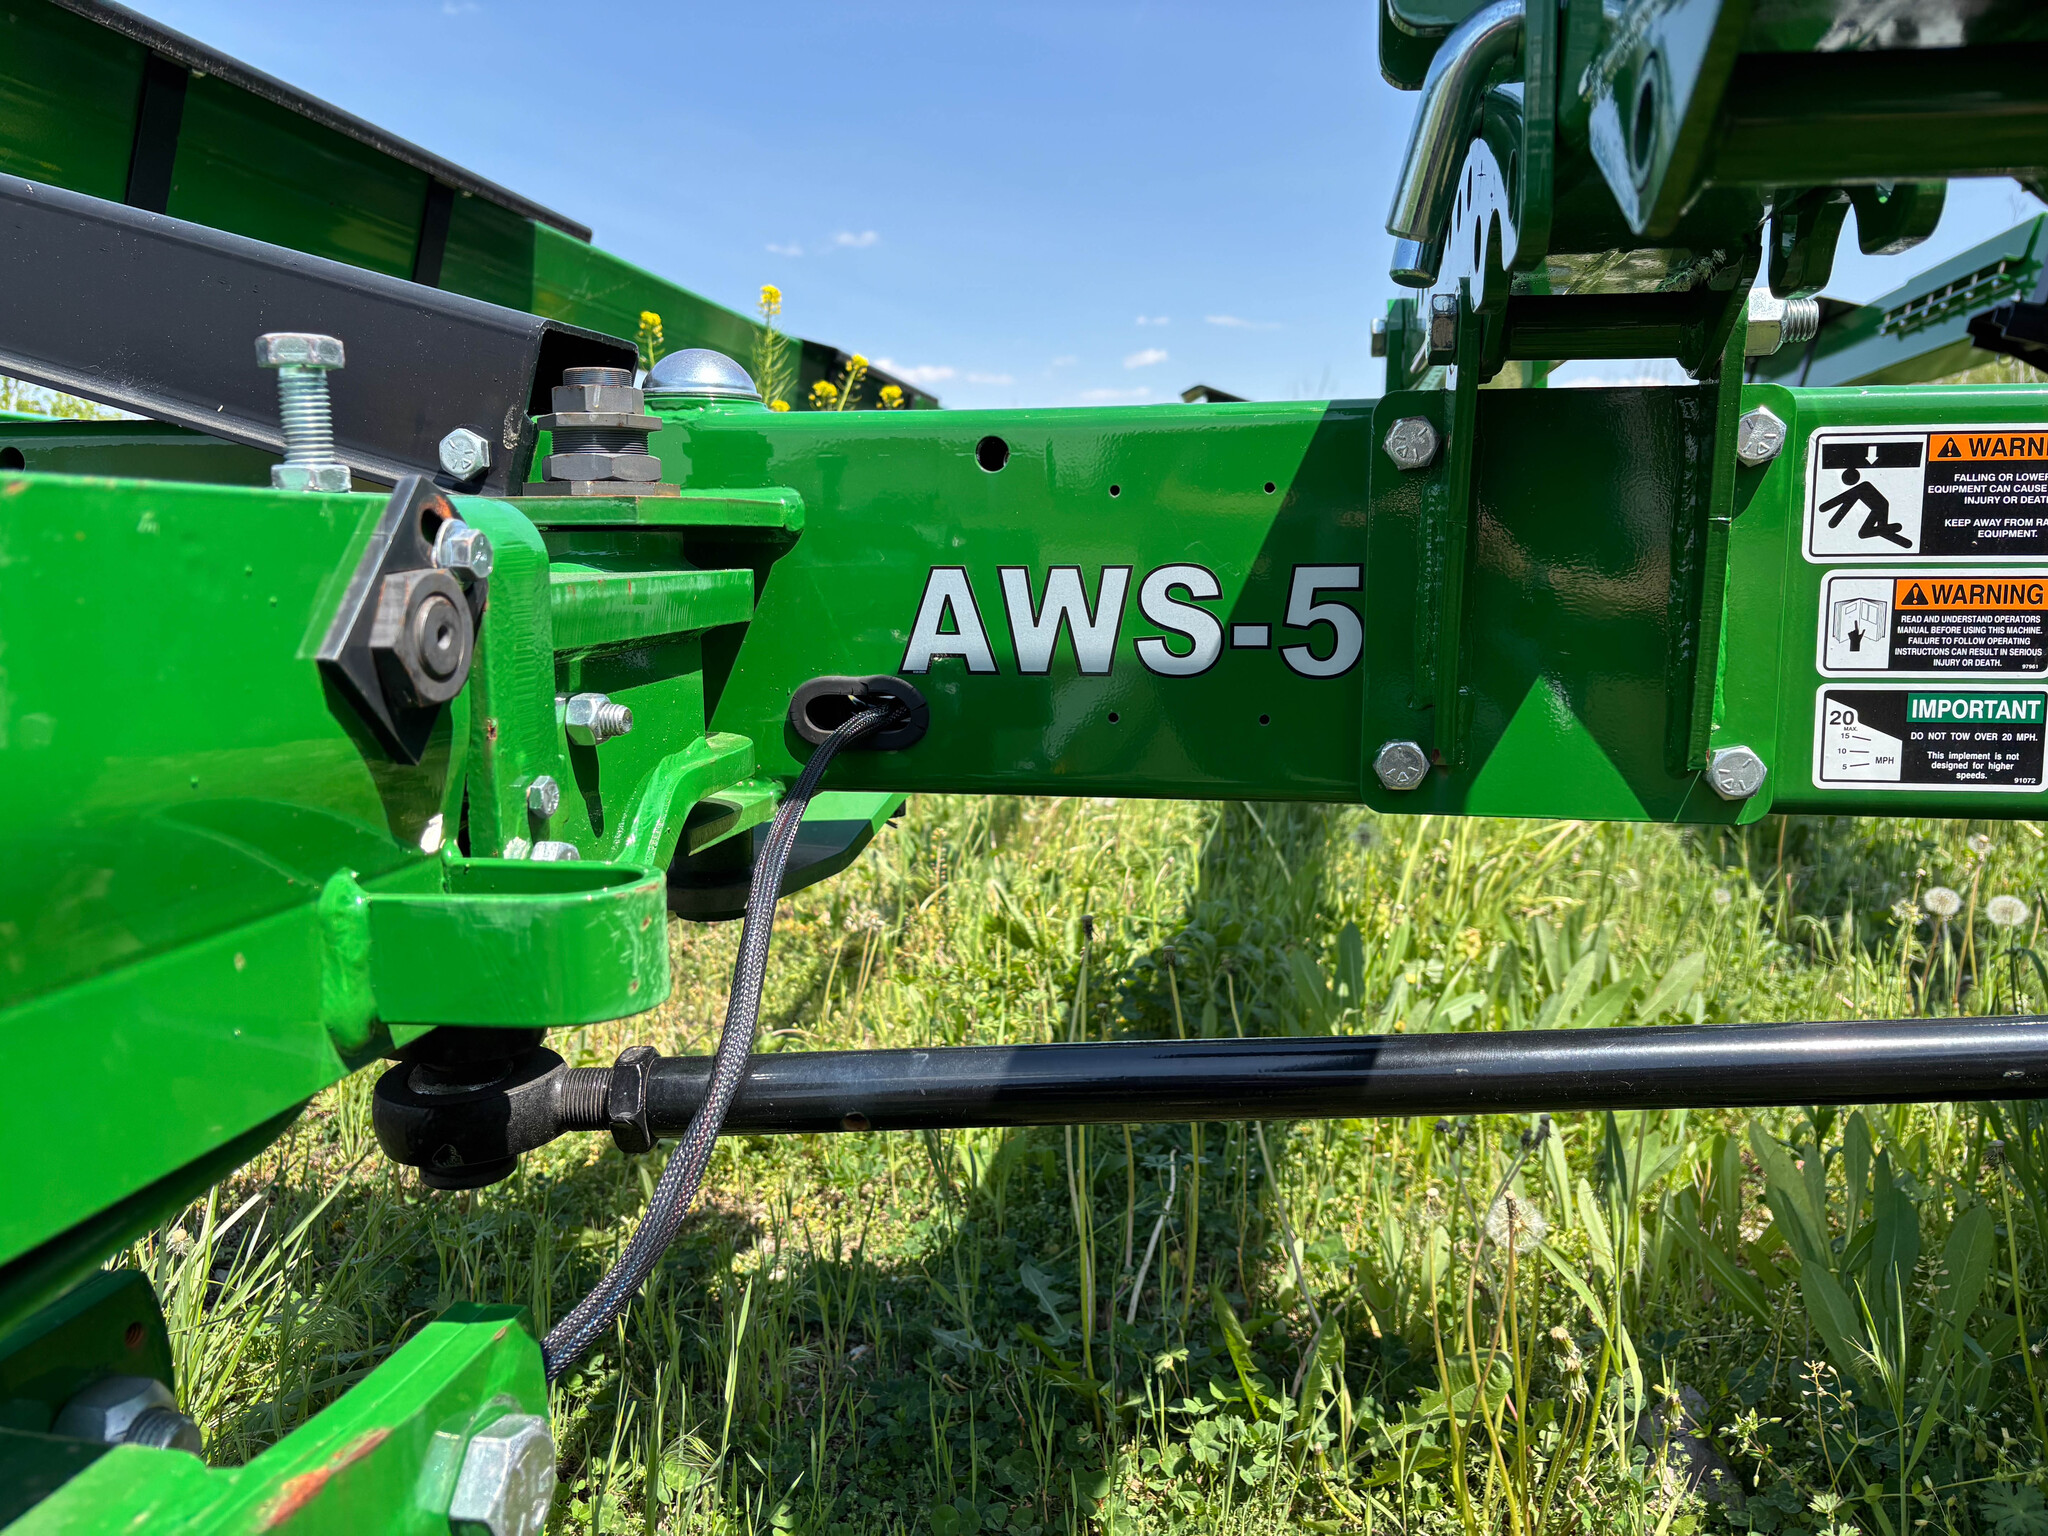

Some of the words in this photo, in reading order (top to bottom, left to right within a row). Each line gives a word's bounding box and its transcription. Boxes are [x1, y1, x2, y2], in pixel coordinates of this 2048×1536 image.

[1954, 473, 1996, 482] FALLING
[1998, 473, 2013, 481] OR
[1928, 485, 1987, 494] EQUIPMENT
[1989, 485, 2011, 493] CAN
[1964, 496, 2000, 504] INJURY
[2003, 496, 2017, 504] OR
[1944, 519, 1971, 527] KEEP
[1973, 519, 2002, 527] AWAY
[2004, 518, 2033, 526] FROM
[1978, 530, 2038, 538] EQUIPMENT.
[1931, 584, 2044, 605] WARNING
[898, 562, 1364, 679] AWS-5
[1901, 615, 1923, 623] READ
[1924, 615, 1940, 623] AND
[1941, 615, 1993, 623] UNDERSTAND
[1994, 615, 2041, 623] OPERATORS
[1897, 626, 1929, 634] MANUAL
[1931, 626, 1961, 634] BEFORE
[1963, 626, 1986, 634] USING
[1988, 626, 2005, 634] THIS
[2006, 626, 2042, 634] MACHINE.
[1908, 637, 1940, 645] FAILURE
[1987, 637, 2030, 645] OPERATING
[1895, 648, 1950, 656] INSTRUCTIONS
[1951, 648, 1967, 656] CAN
[1969, 648, 1999, 656] RESULT
[2000, 648, 2008, 656] IN
[2009, 648, 2042, 656] SERIOUS
[1911, 699, 2041, 719] IMPORTANT
[1830, 710, 1854, 725] 20
[1910, 732, 1924, 740] DO
[1928, 732, 1946, 741] NOT
[1950, 732, 1970, 741] TOW
[1974, 733, 1998, 741] OVER
[2002, 733, 2012, 741] 20
[2016, 733, 2038, 741] MPH.
[1875, 756, 1894, 764] MPH
[1949, 752, 1990, 761] implement
[1995, 752, 2002, 760] is
[1931, 762, 1968, 771] designed
[1988, 762, 2014, 771] higher
[1956, 772, 1988, 780] speeds.
